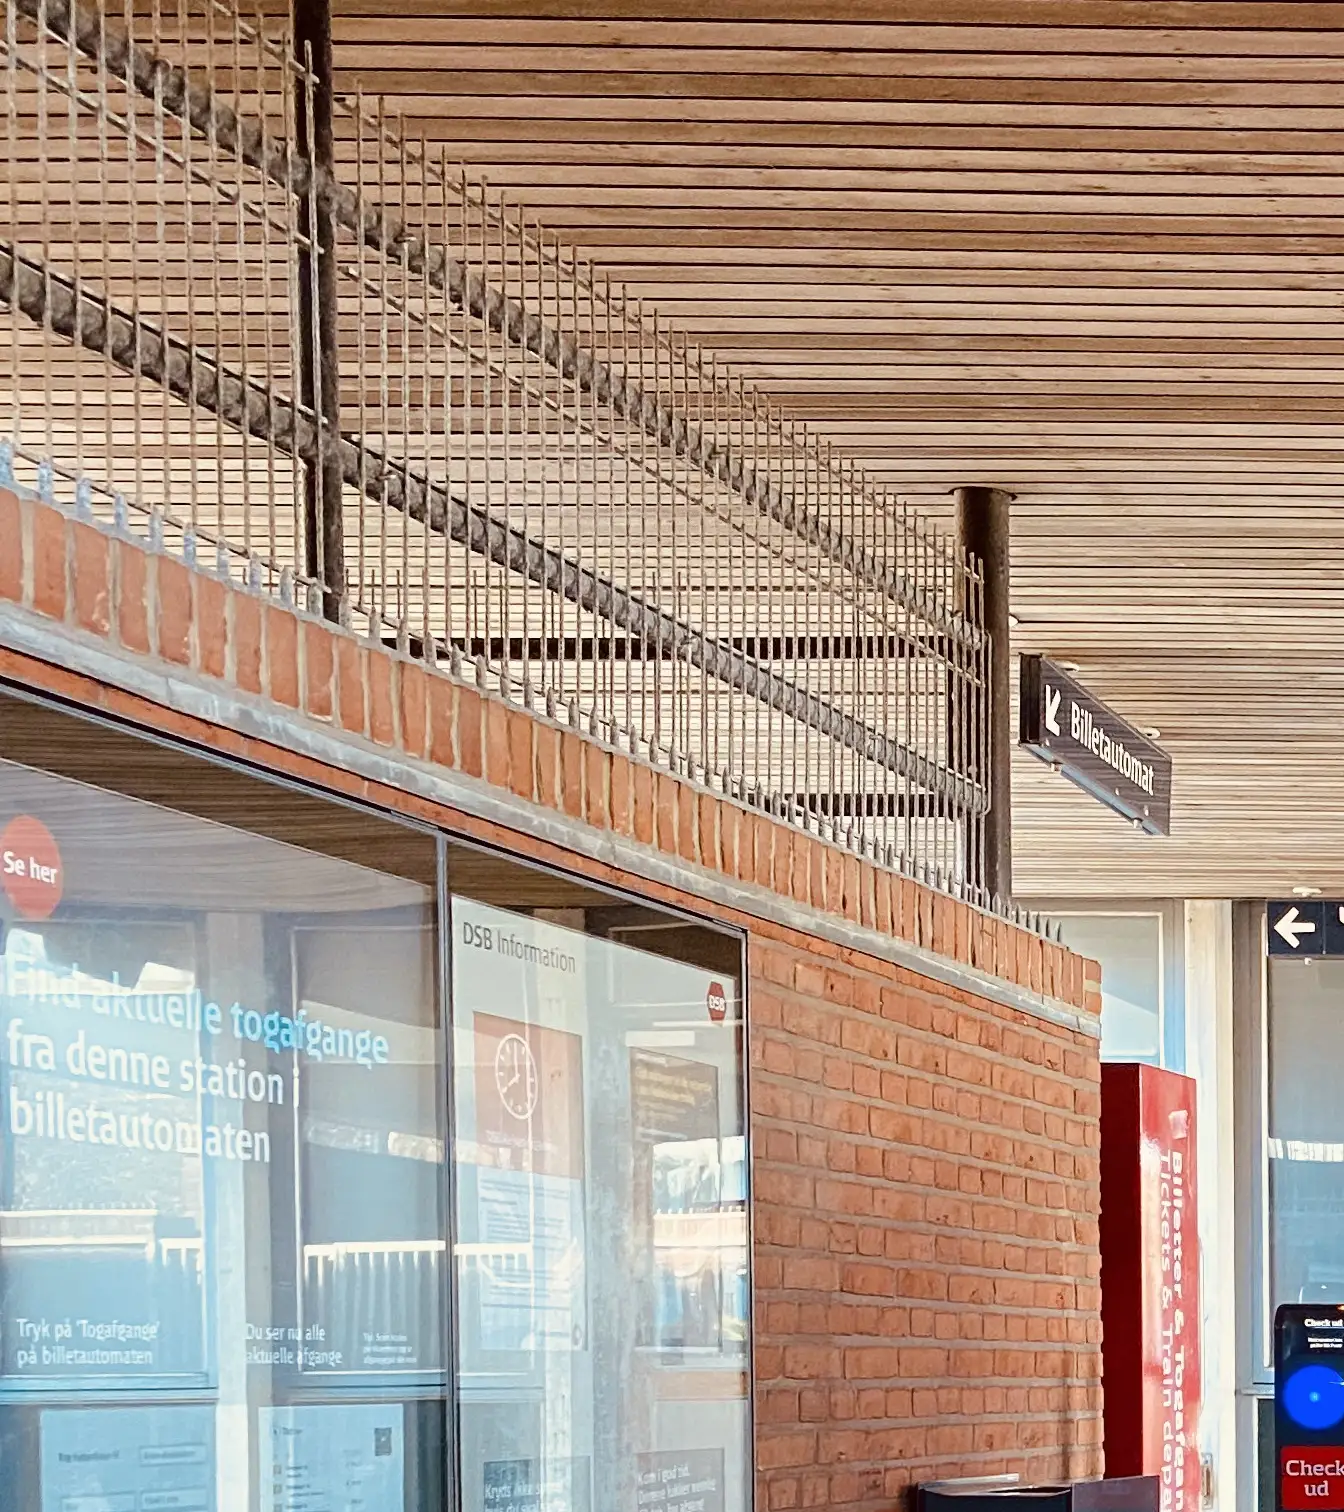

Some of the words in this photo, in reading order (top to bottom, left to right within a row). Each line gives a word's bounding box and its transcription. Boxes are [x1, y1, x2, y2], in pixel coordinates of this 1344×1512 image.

[1071, 701, 1154, 796] Billetautomat
[3, 850, 25, 876] Se
[29, 856, 59, 884] her
[463, 921, 493, 950] DSB
[497, 928, 576, 973] Information
[92, 970, 223, 1035] aktuelle
[230, 1001, 390, 1070] togafgange
[708, 994, 727, 1012] DSB
[6, 1018, 56, 1071] fra
[66, 1030, 171, 1088] denne
[180, 1055, 284, 1105] station
[10, 1085, 270, 1163] billetautomaten
[1160, 1149, 1172, 1273] Tickets
[1172, 1151, 1184, 1300] Billetter
[1162, 1286, 1173, 1311] &
[16, 1319, 50, 1342] Tryk
[54, 1320, 72, 1343] på
[17, 1346, 36, 1367] på
[42, 1346, 152, 1366] billetautomaten
[305, 1323, 326, 1341] alle
[1162, 1328, 1174, 1407] Train
[1303, 1480, 1330, 1497] ud
